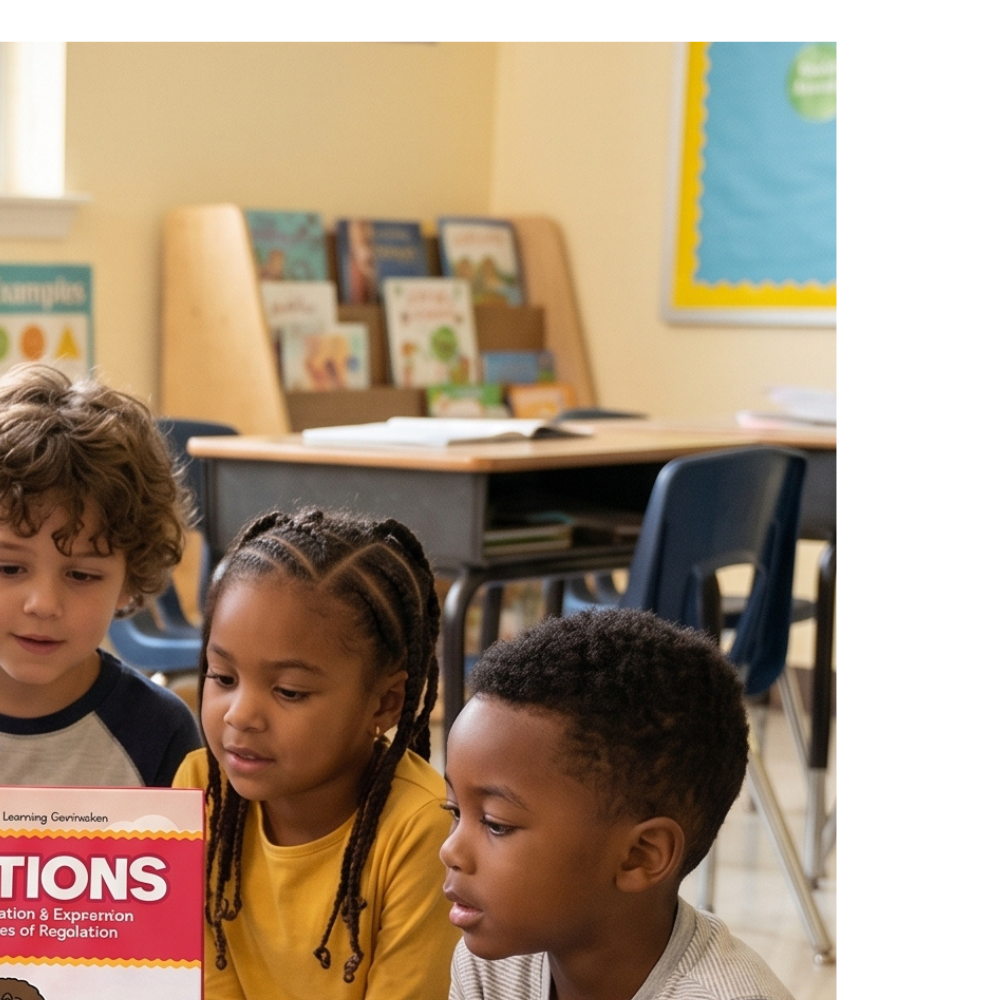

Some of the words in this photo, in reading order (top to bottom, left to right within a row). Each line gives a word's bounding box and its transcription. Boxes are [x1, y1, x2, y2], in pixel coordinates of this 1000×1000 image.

[2, 811, 47, 825] Learning
[40, 907, 49, 921] &
[19, 924, 35, 937] of
